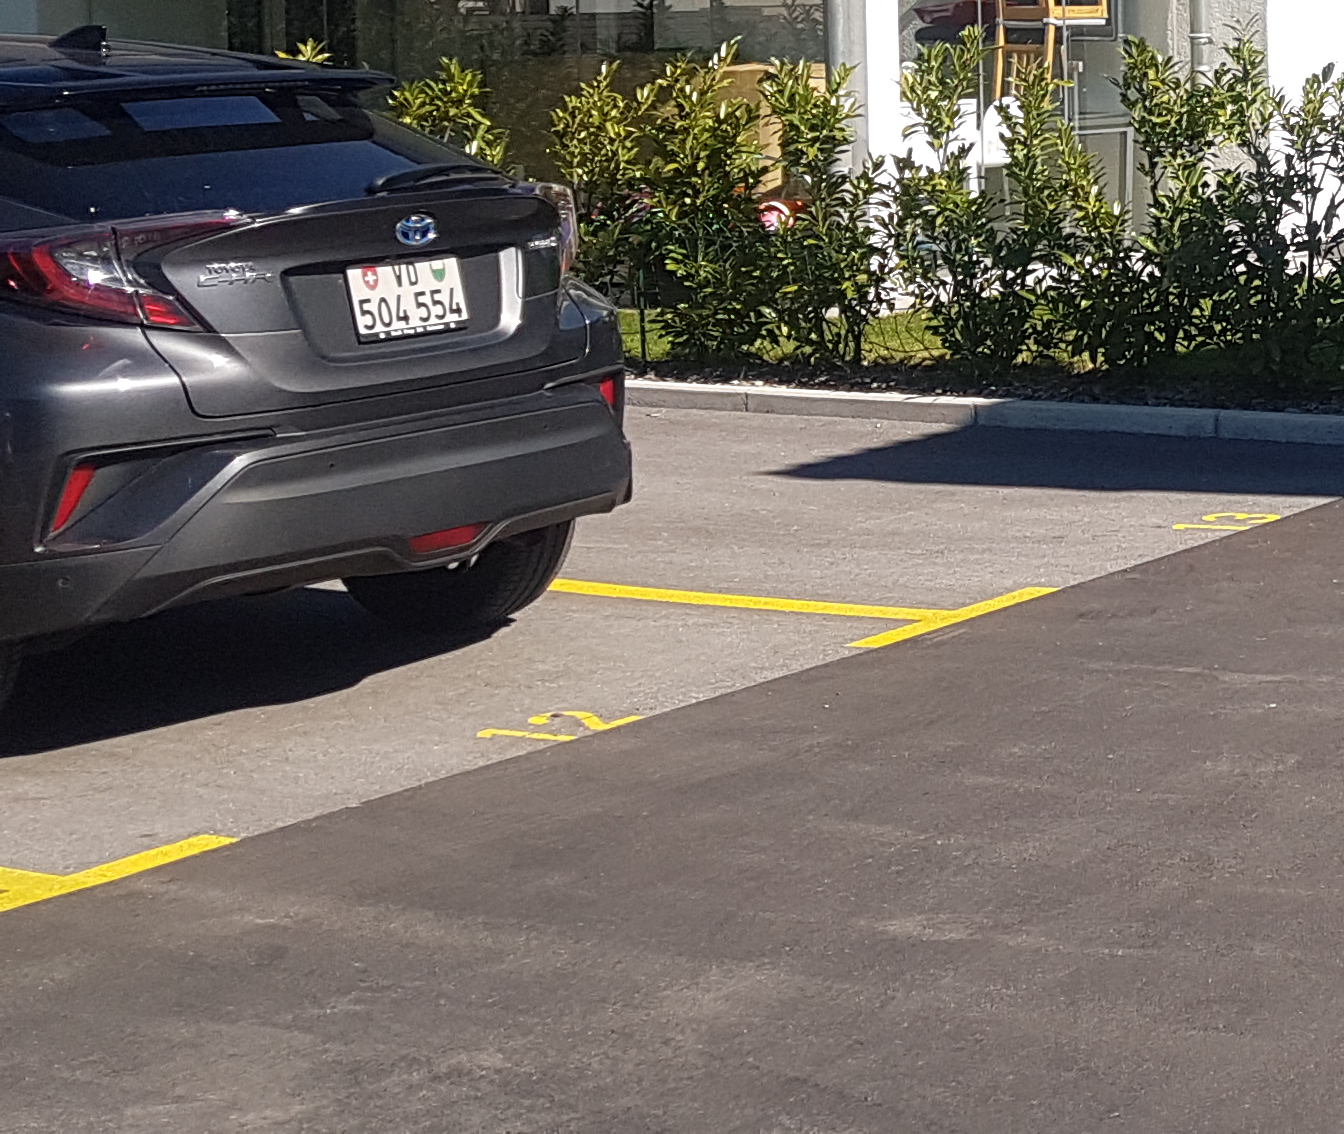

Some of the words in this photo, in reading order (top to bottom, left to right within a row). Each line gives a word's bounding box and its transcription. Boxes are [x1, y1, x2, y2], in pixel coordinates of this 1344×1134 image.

[391, 261, 419, 287] VD
[358, 294, 410, 331] 504
[413, 287, 463, 323] 554
[1172, 512, 1281, 530] 13
[477, 711, 643, 741] 12
